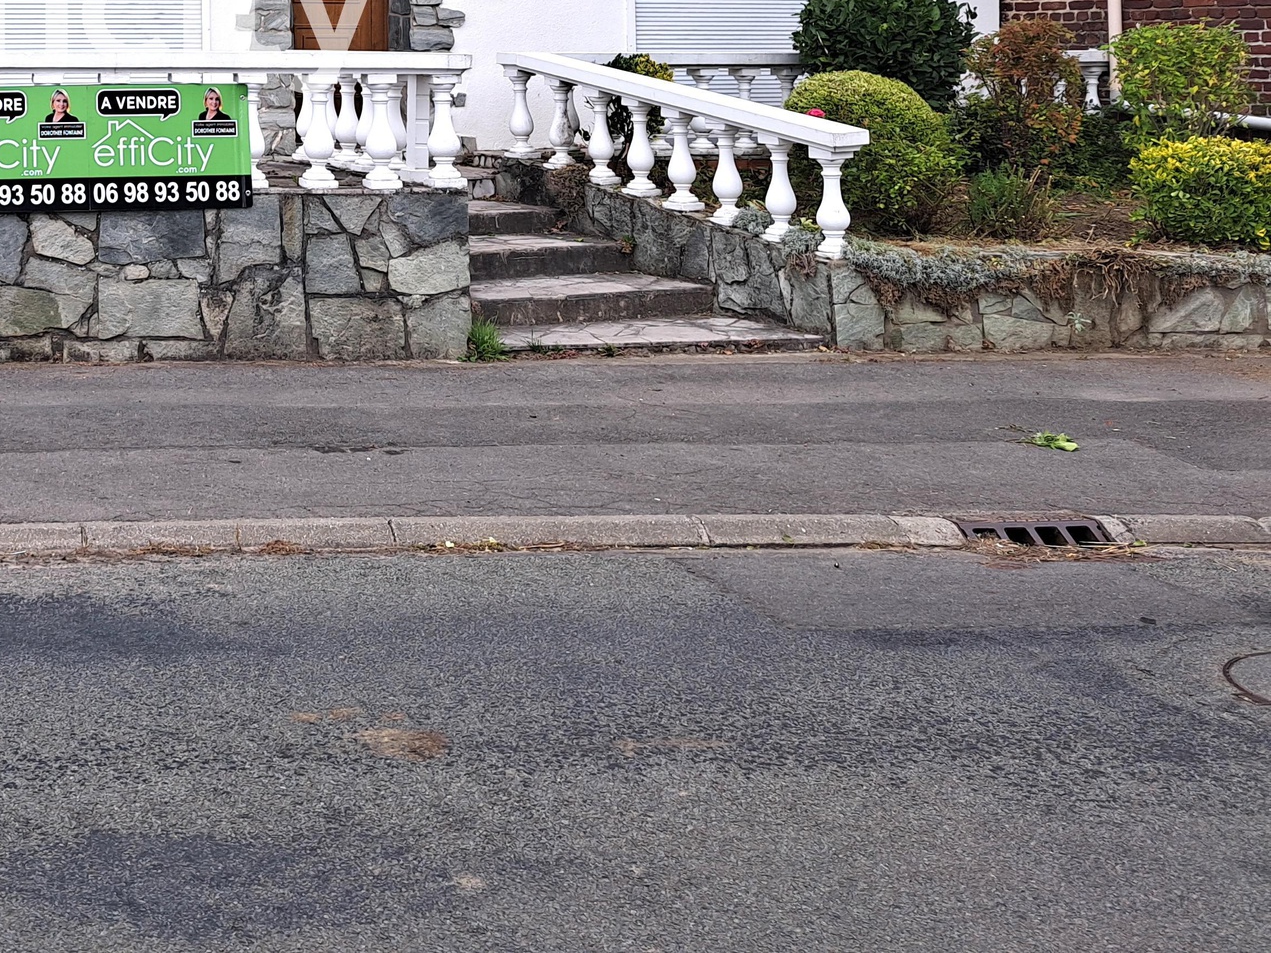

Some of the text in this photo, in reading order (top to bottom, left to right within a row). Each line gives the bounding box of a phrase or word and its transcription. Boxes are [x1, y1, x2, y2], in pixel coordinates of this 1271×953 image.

[100, 95, 177, 110] A VENDRE
[93, 136, 214, 172] effiCity
[21, 168, 43, 176] .com
[175, 166, 197, 174] .com
[30, 184, 55, 205] 50
[61, 183, 87, 204] 88
[93, 180, 240, 204] 06 98 93 50 88
